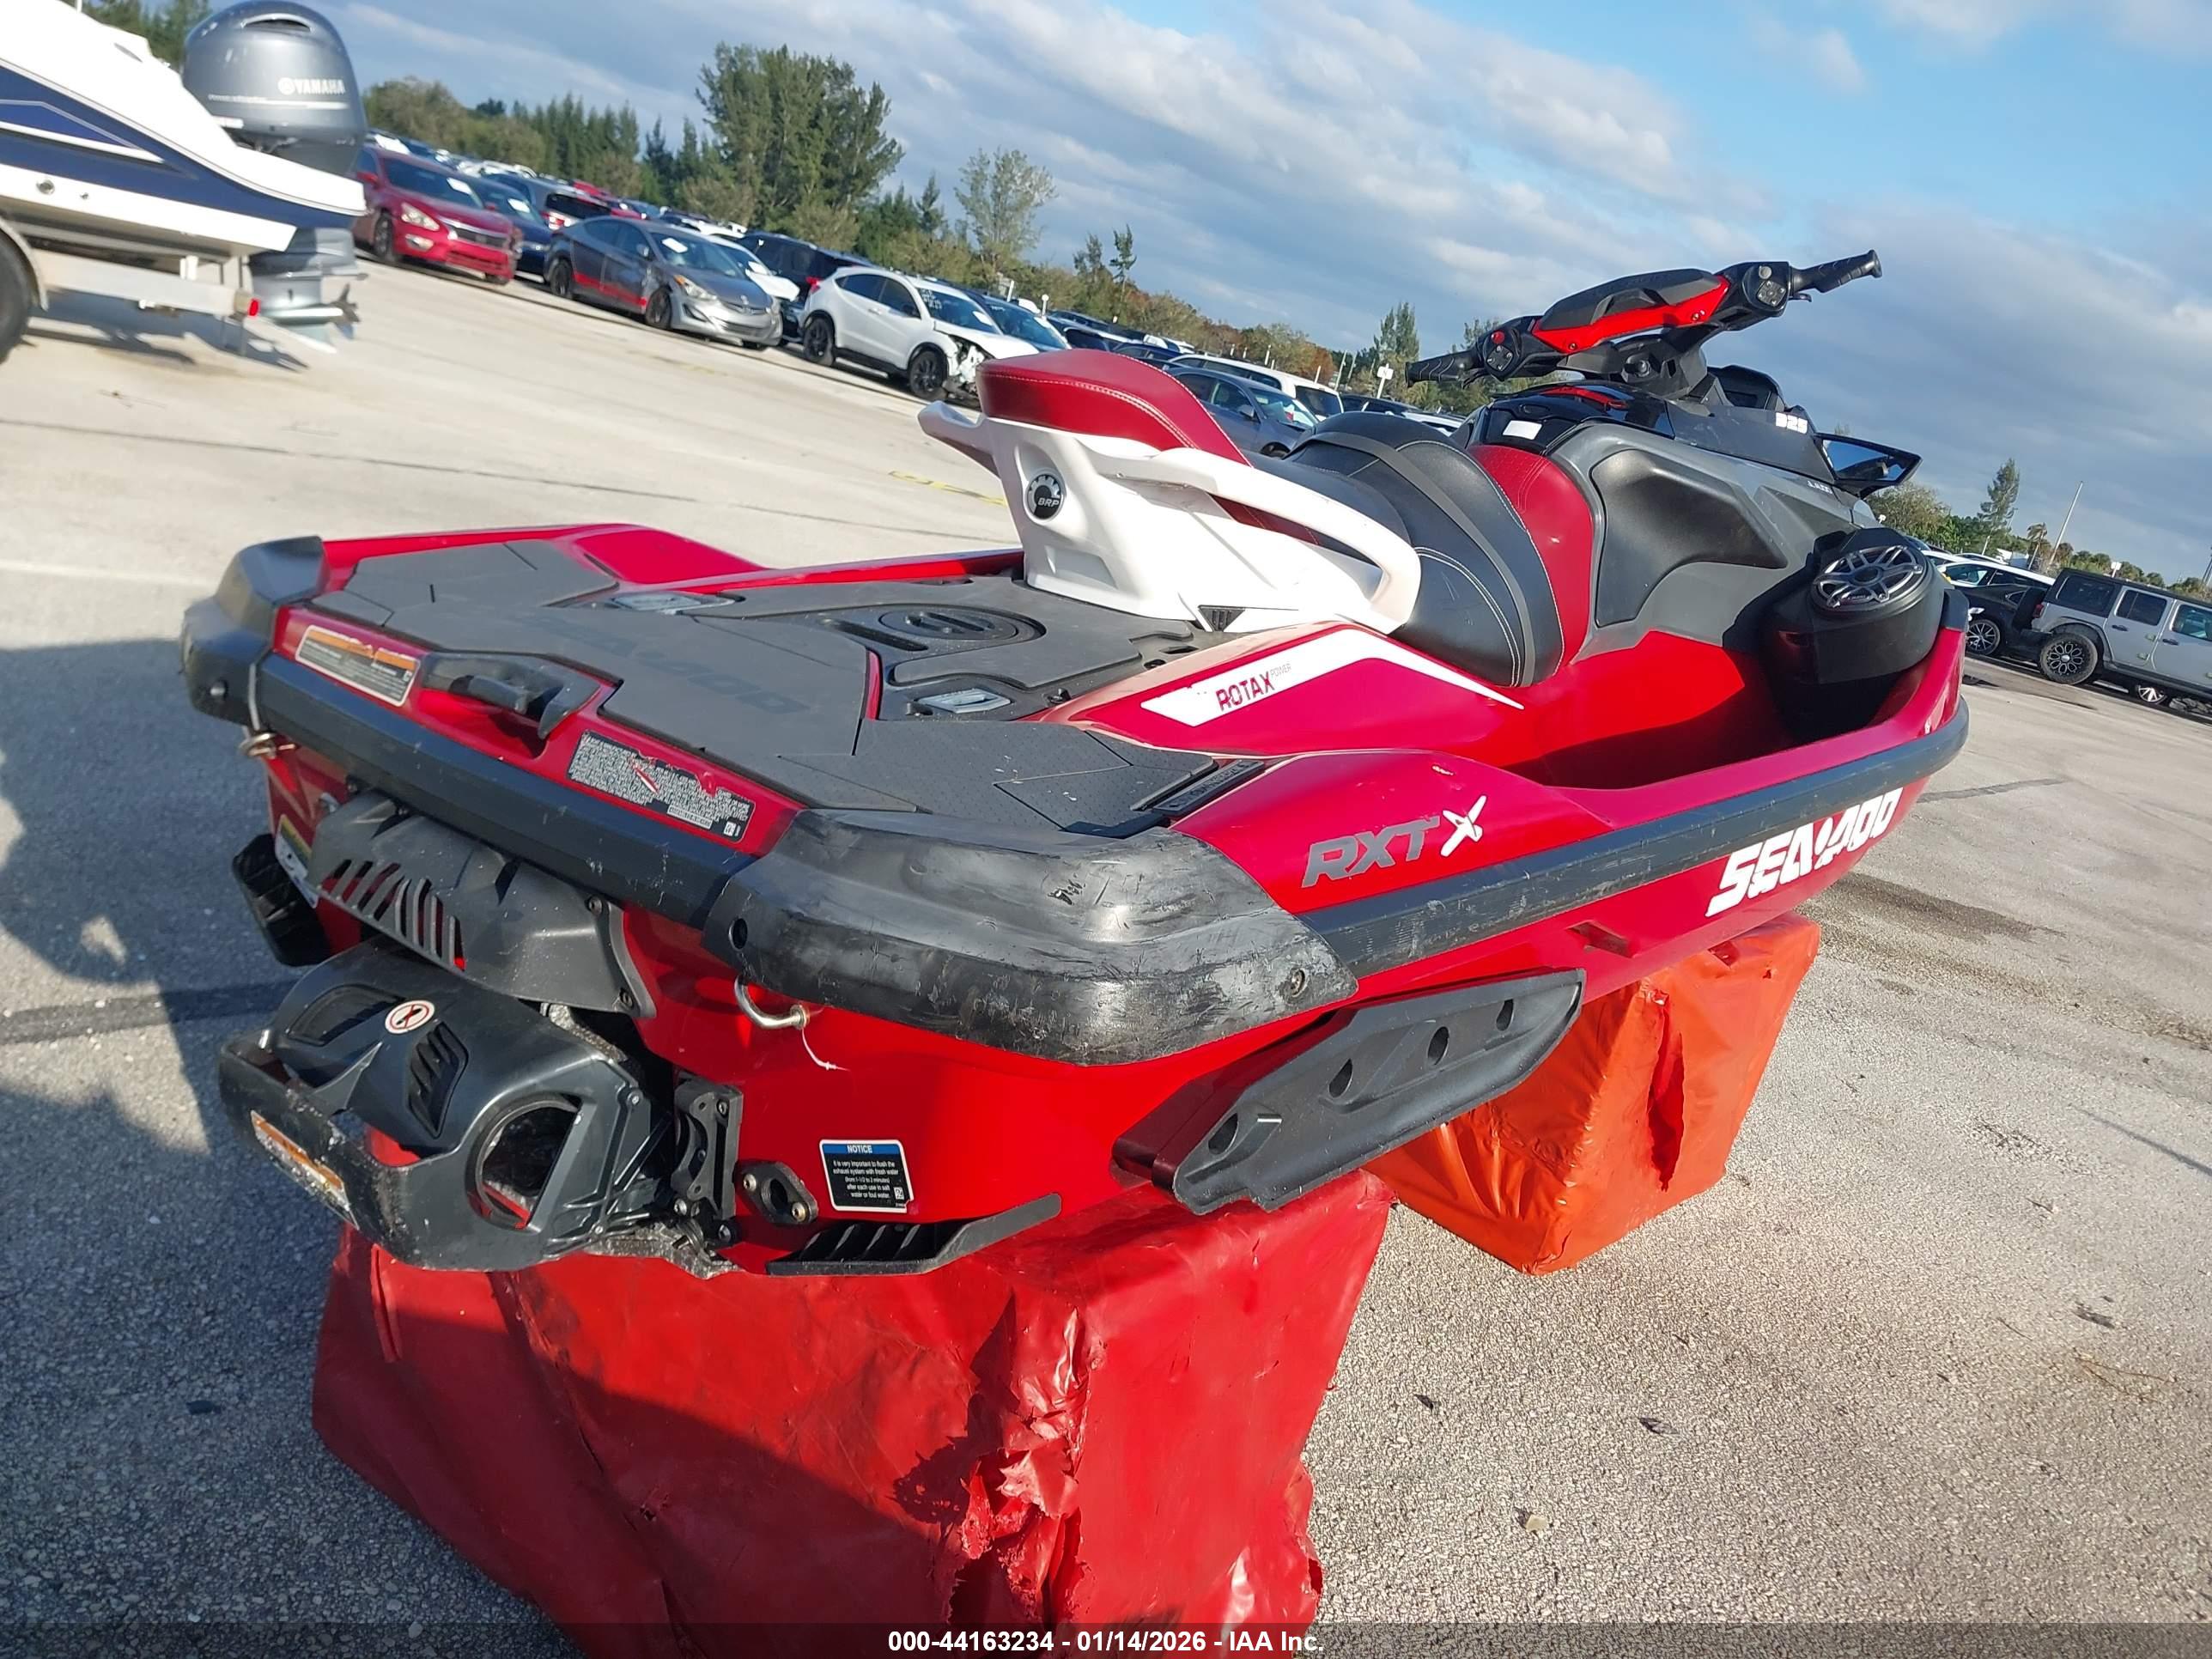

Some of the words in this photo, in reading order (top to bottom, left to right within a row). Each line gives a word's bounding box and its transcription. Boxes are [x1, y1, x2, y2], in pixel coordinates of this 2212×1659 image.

[295, 79, 346, 95] YAMAHA
[1037, 497, 1060, 507] BRP
[1215, 671, 1275, 712] ROTAX
[1270, 662, 1291, 678] POWER
[847, 1145, 873, 1153] NOTICE
